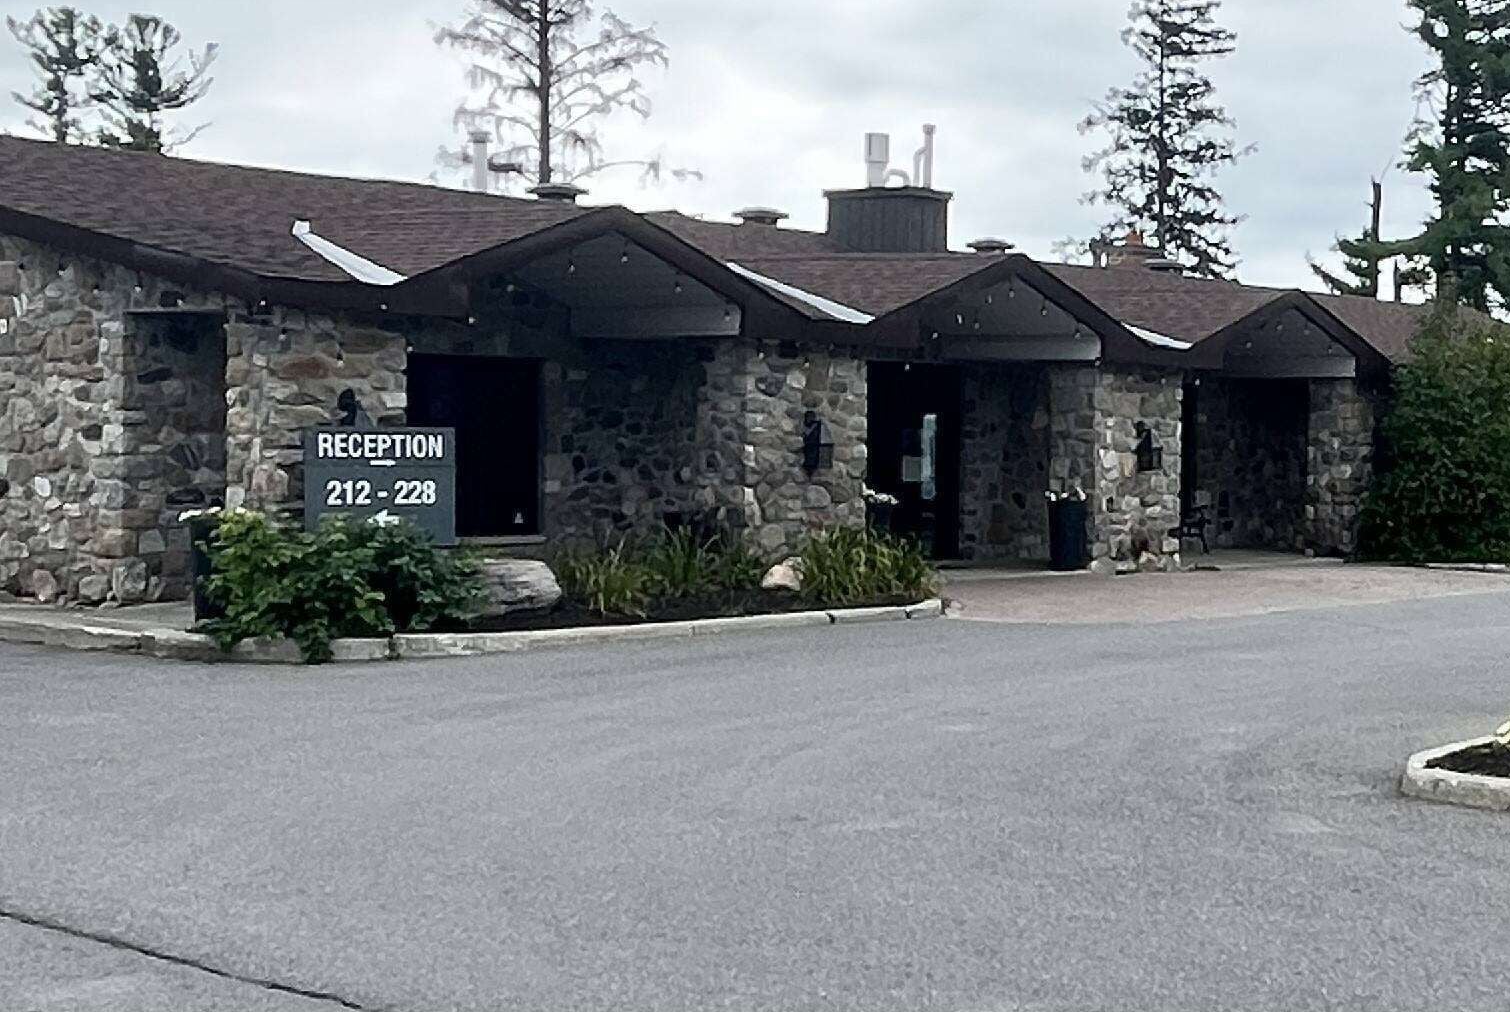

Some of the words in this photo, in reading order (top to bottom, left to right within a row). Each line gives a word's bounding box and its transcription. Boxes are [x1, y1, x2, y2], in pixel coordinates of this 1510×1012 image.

[318, 432, 443, 458] RECEPTION
[326, 480, 372, 505] 212
[394, 480, 436, 504] 228
